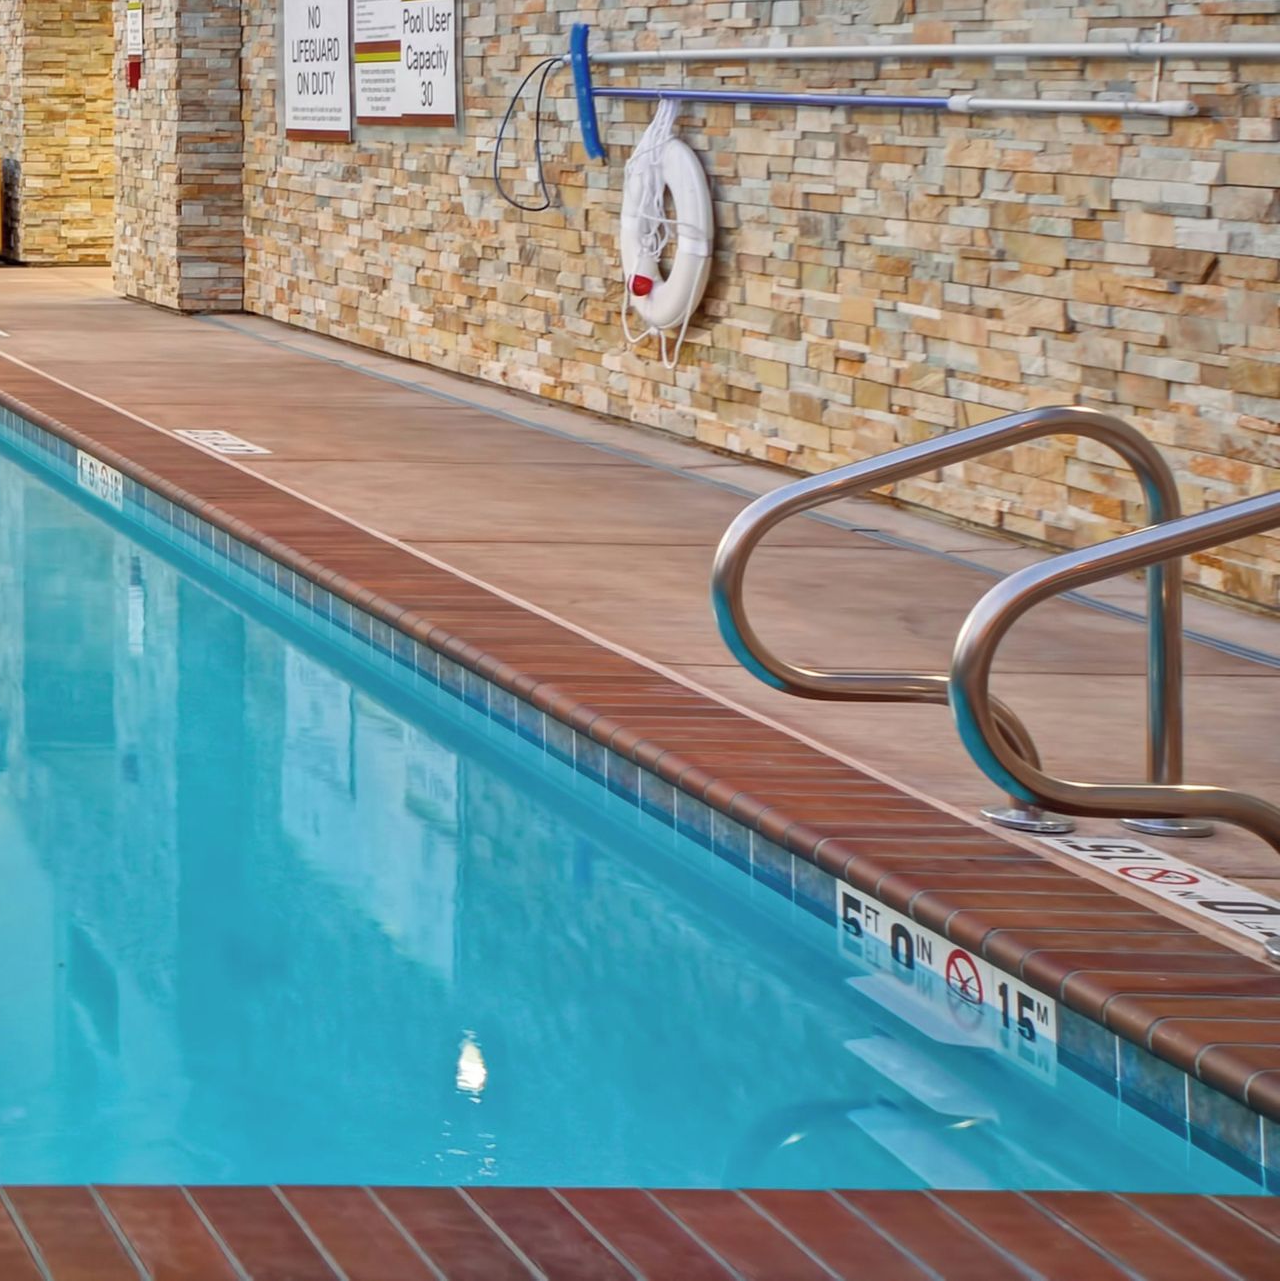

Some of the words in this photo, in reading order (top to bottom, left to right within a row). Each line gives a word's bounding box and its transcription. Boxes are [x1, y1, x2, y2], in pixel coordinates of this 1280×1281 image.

[307, 5, 321, 29] NO
[403, 8, 424, 34] Pool
[427, 6, 452, 32] User
[291, 37, 340, 63] LIFEGUARD
[406, 43, 449, 77] Capacity
[297, 72, 309, 95] ON
[312, 71, 335, 95] DUTY
[421, 80, 433, 107] 30
